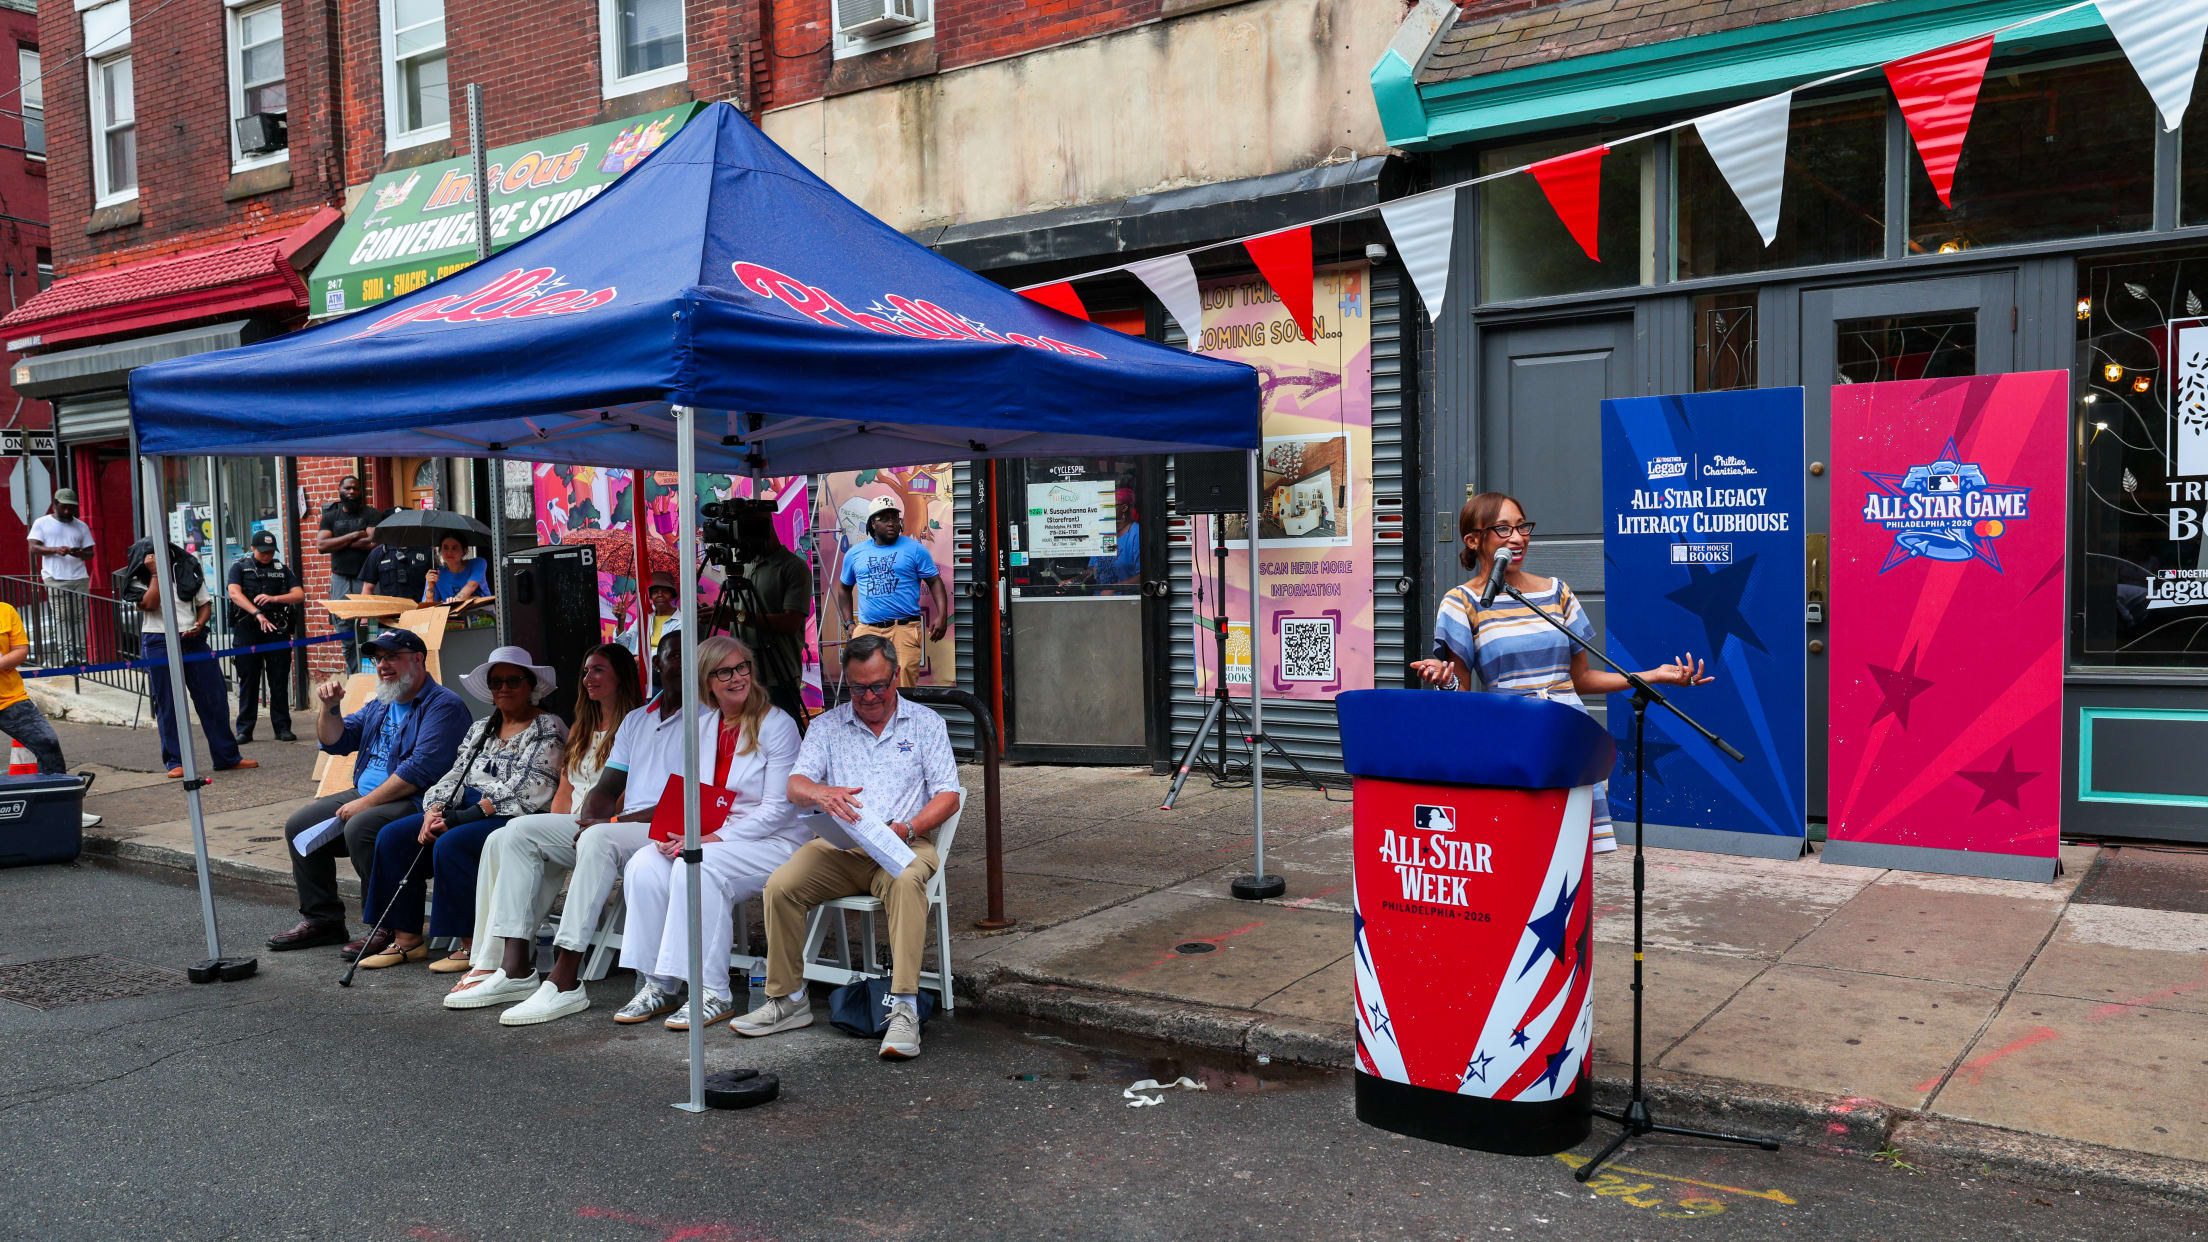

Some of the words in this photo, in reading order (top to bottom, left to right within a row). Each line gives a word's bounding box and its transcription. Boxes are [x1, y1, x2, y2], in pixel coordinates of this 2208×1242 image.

[422, 168, 473, 211] In
[500, 142, 590, 194] Out
[518, 183, 612, 233] STOR
[327, 278, 343, 290] 24/7
[362, 277, 384, 302] SODA
[393, 269, 427, 296] SNACKS
[328, 293, 342, 304] ATM
[1199, 285, 1236, 310] LOT
[1240, 281, 1281, 306] TWI
[4, 438, 24, 449] ON
[35, 438, 56, 449] WA
[1647, 461, 1688, 476] Legacy
[1713, 454, 1746, 467] Phillies
[1631, 489, 1662, 510] ALL
[1664, 488, 1703, 509] STAR
[1706, 487, 1767, 508] LEGACY
[1863, 494, 1906, 520] ALL
[1908, 492, 1963, 519] STAR
[1965, 491, 2027, 518] GAME
[1046, 516, 1080, 524] (Storefront)
[1050, 508, 1087, 516] Susquehanna
[1617, 514, 1690, 534] LITERACY
[1692, 511, 1790, 533] CLUBHOUSE
[1886, 520, 1945, 528] PHILADELPHIA
[1951, 519, 1973, 527] 2026
[2169, 507, 2208, 541] B
[580, 548, 594, 566] B
[1689, 551, 1729, 562] BOOKS
[1259, 562, 1289, 575] SCAN
[1290, 561, 1319, 575] HERE
[1320, 560, 1353, 574] MORE
[1270, 582, 1342, 597] INFORMATION
[1225, 673, 1252, 683] OOKS
[1378, 829, 1426, 867] ALL
[1429, 833, 1494, 874] STAR
[1394, 864, 1470, 907] WEEK
[1382, 900, 1456, 919] PHILADELPHIA
[1464, 911, 1492, 923] 2026
